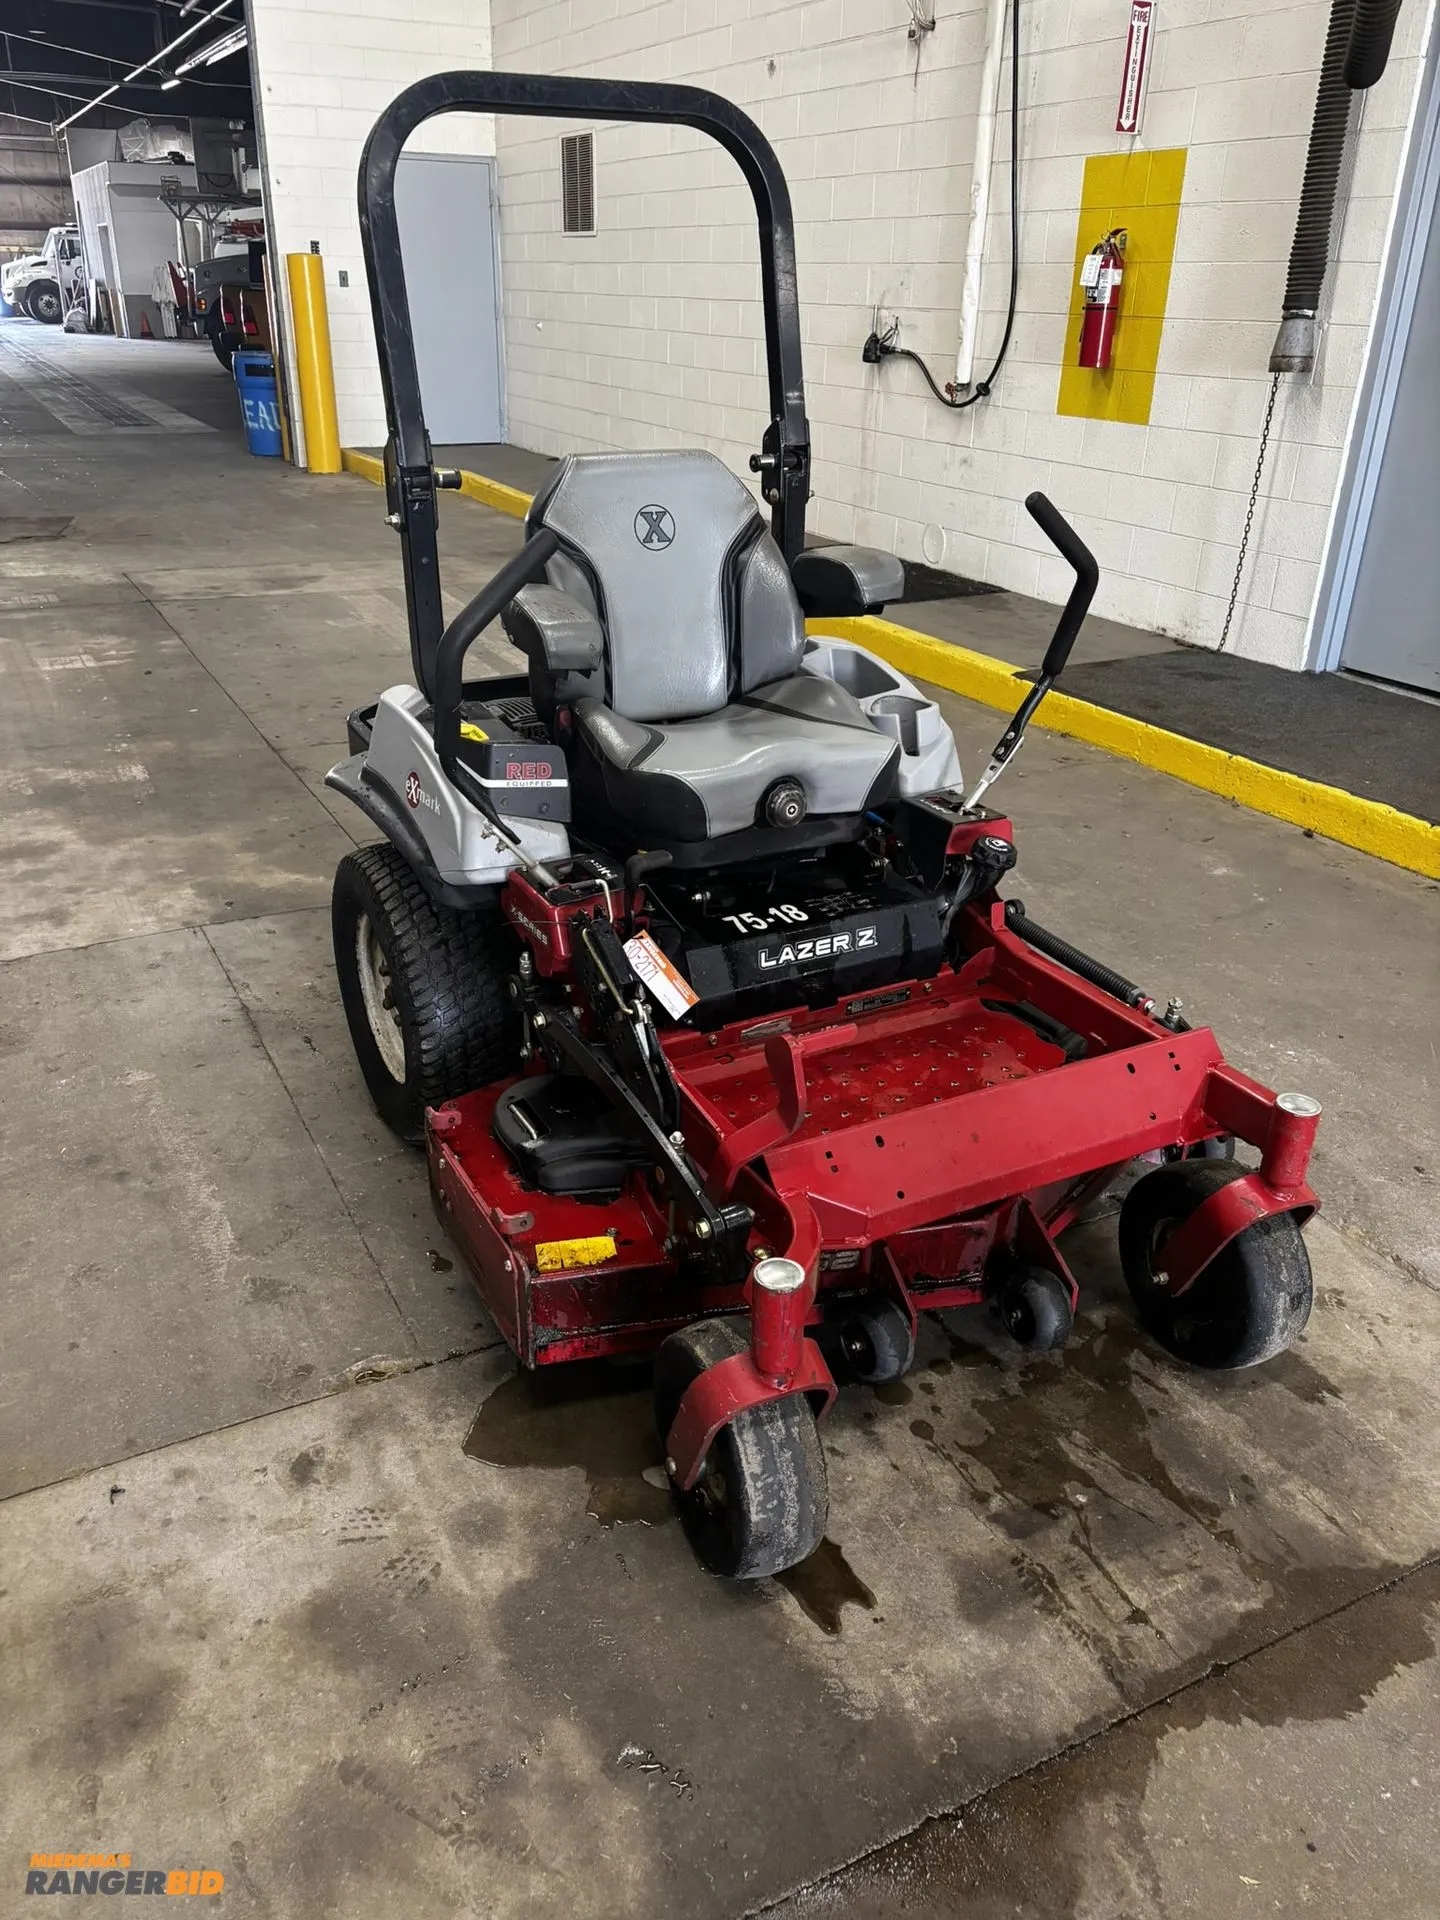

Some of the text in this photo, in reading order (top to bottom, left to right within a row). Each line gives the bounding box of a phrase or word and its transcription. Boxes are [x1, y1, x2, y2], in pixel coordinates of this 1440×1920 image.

[1133, 9, 1149, 22] FIRE
[1125, 25, 1142, 120] EXTINGUISHER
[640, 511, 671, 543] X
[506, 762, 552, 780] RED
[506, 780, 553, 788] EQUIPPED
[721, 904, 809, 934] 75-18
[625, 940, 660, 982] 30-2171
[759, 927, 876, 969] LAZER Z
